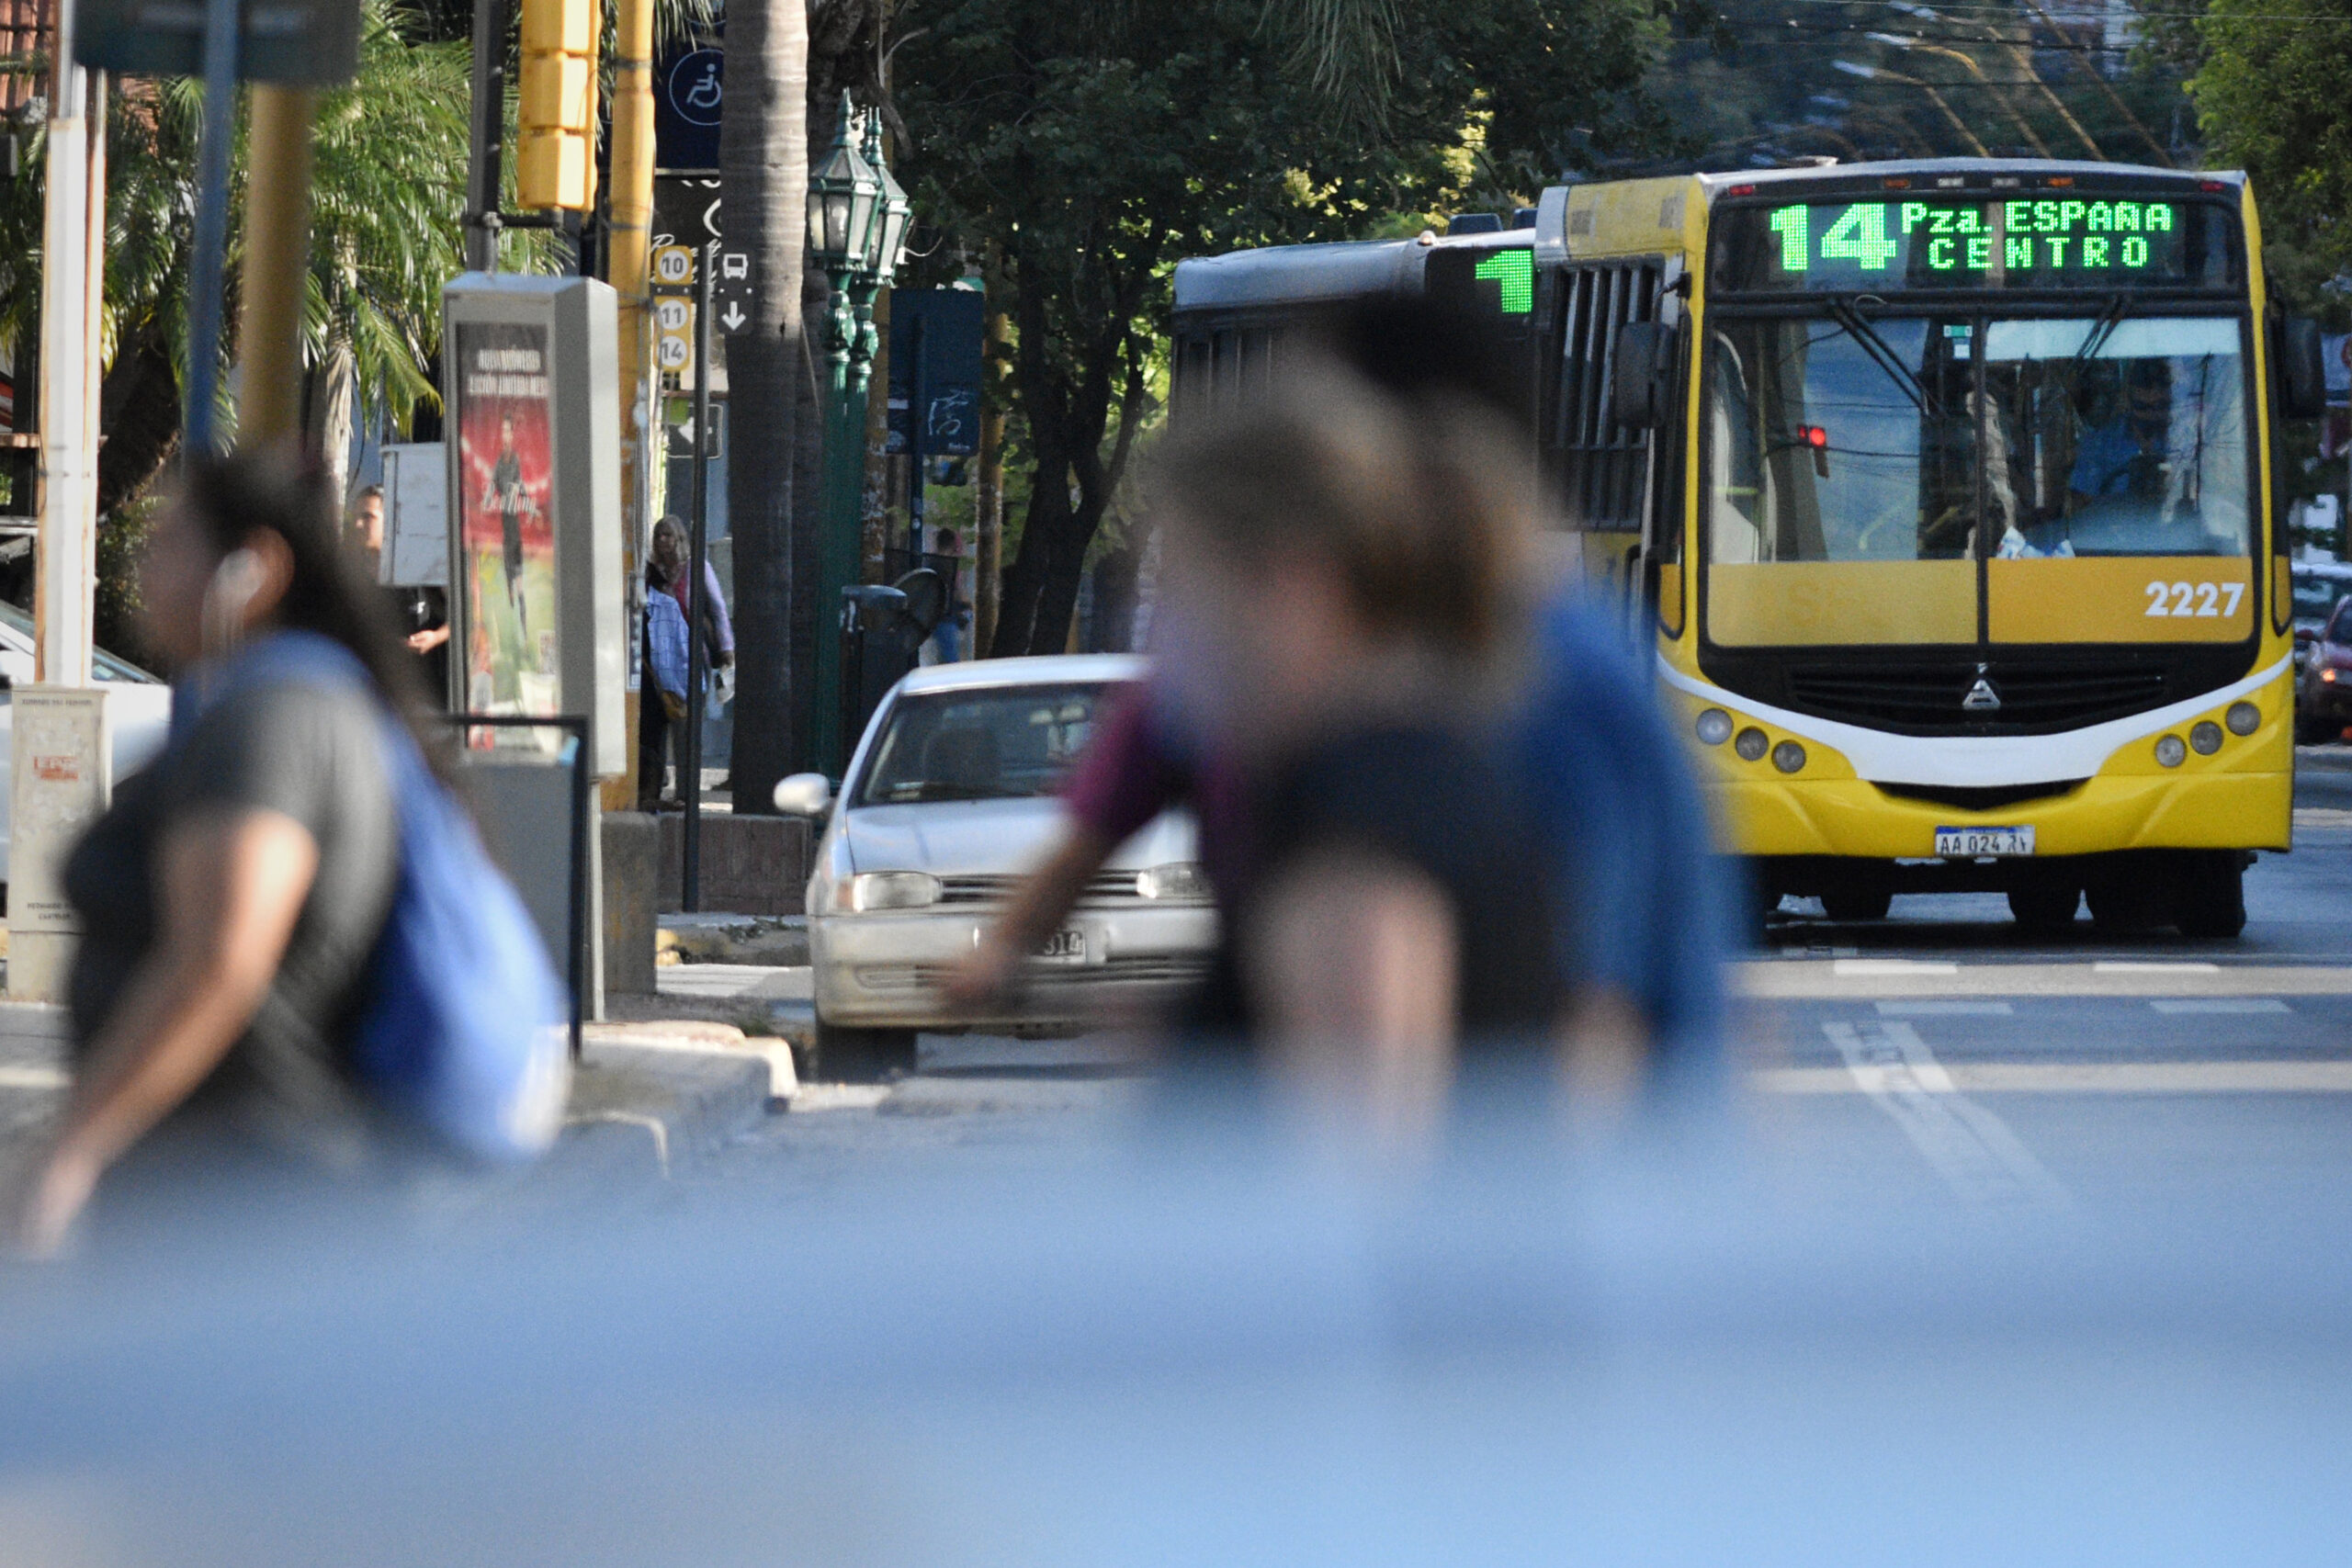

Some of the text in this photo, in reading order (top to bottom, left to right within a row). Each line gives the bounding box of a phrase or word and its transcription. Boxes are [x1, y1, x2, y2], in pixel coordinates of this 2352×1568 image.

[1902, 202, 1994, 233] Pza.
[1770, 203, 1896, 270] 14
[1928, 235, 2148, 269] CENTRO
[662, 257, 684, 274] 10
[662, 307, 681, 323] 11
[662, 343, 683, 360] 14
[2145, 581, 2245, 616] 2227
